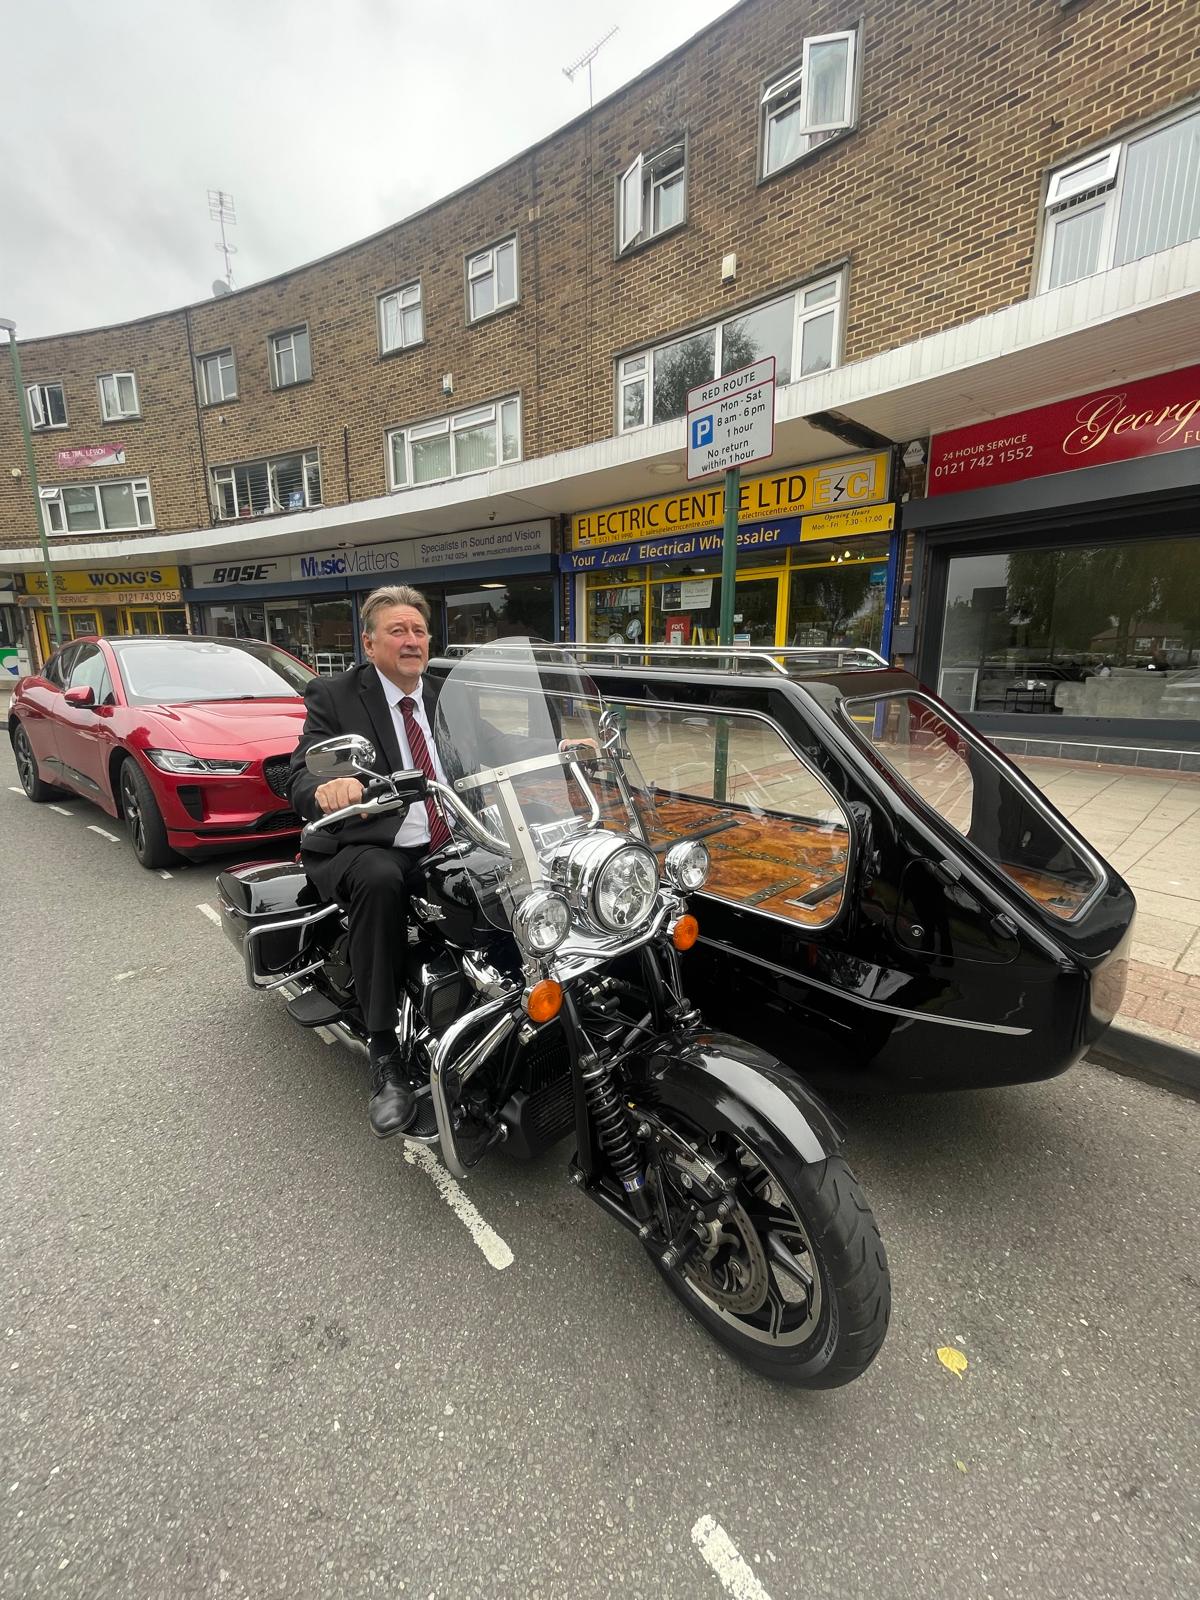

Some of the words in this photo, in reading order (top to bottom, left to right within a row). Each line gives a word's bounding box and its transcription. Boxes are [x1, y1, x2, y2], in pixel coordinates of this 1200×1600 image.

[702, 386, 720, 401] RED
[723, 371, 756, 392] ROUTE
[720, 399, 739, 412] Mon
[746, 389, 762, 403] Sat
[724, 413, 737, 424] am
[751, 403, 766, 416] pm
[697, 419, 710, 446] P
[727, 428, 731, 438] 1
[733, 422, 754, 436] hour
[707, 449, 719, 459] No
[721, 439, 749, 455] return
[943, 451, 954, 462] 24
[955, 444, 984, 458] HOUR
[986, 433, 1028, 451] SERVICE
[701, 459, 727, 472] within
[735, 448, 755, 462] hour
[934, 461, 965, 477] 0121
[969, 454, 994, 470] 742
[998, 445, 1034, 463] 1552
[578, 503, 660, 540] ELECTRIC
[758, 474, 807, 508] LTD
[824, 510, 849, 521] Opening
[851, 508, 870, 518] Hours
[812, 523, 825, 531] Mon
[831, 520, 839, 528] Fri
[845, 518, 859, 526] 7.30
[864, 515, 883, 524] 17.00
[421, 540, 459, 554] Specialists
[460, 539, 468, 548] in
[469, 535, 495, 548] Sound
[496, 532, 512, 543] and
[514, 528, 541, 541] Vision
[572, 555, 595, 568] Your
[601, 547, 631, 565] Local
[639, 538, 695, 559] Electrical
[699, 527, 780, 551] Whesaler
[206, 563, 277, 584] BOSE
[300, 549, 400, 578] MusicMatters
[88, 570, 162, 586] WONG'S
[60, 595, 88, 604] SERVICE
[118, 592, 137, 602] 0121
[140, 591, 155, 601] 743
[156, 591, 177, 600] 0195
